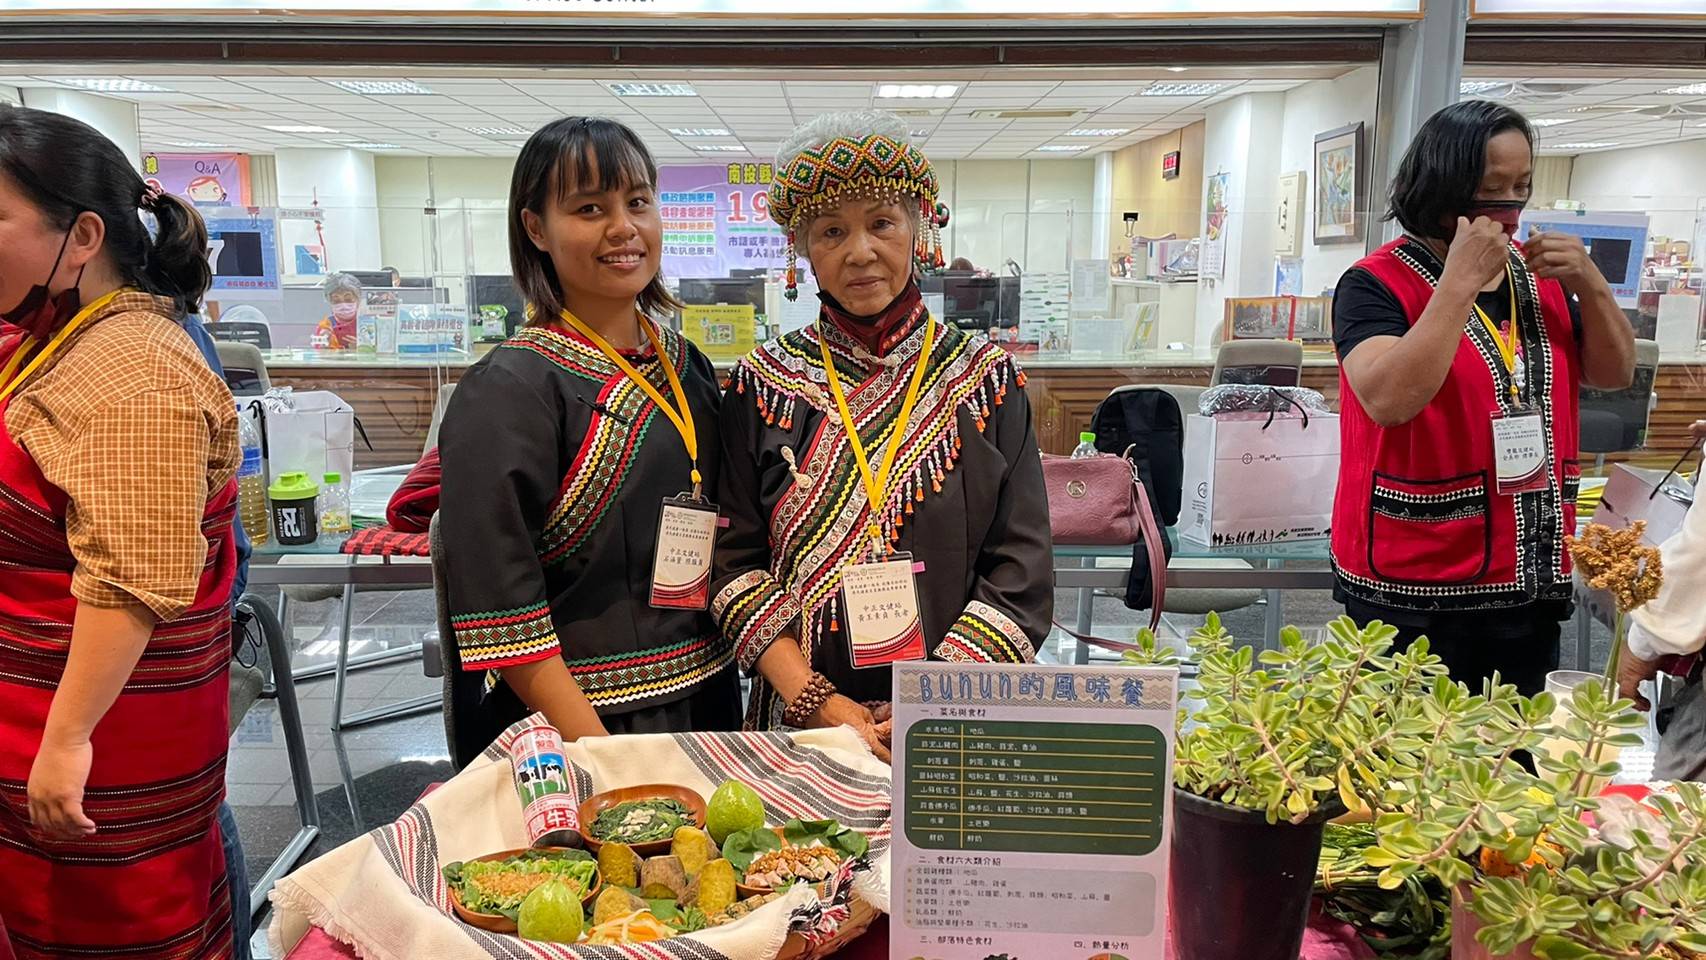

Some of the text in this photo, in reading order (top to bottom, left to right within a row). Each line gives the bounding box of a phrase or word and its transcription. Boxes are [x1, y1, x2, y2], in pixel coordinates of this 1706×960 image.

[194, 160, 221, 175] Q&A
[727, 162, 772, 185] 南投縣
[281, 508, 299, 537] 24
